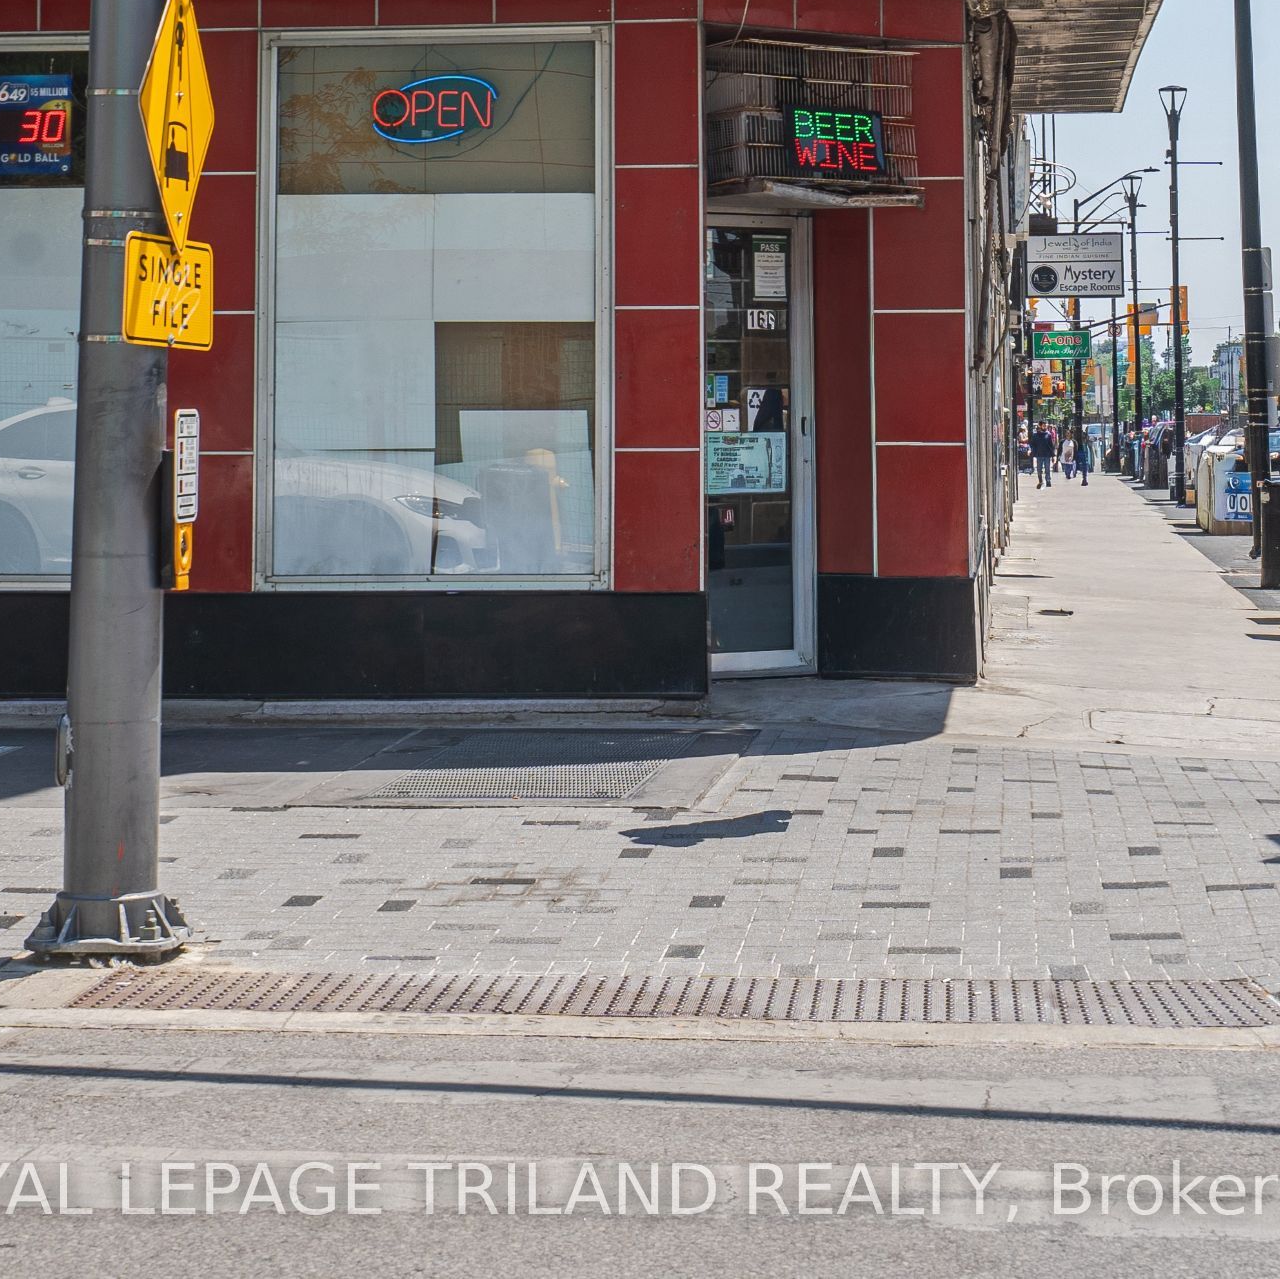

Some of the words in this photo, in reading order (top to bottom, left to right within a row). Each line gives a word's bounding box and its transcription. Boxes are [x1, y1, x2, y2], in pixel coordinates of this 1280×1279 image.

[39, 86, 69, 98] MILLION
[372, 88, 493, 129] OPEN
[19, 110, 67, 143] 30
[793, 109, 875, 143] BEER
[35, 153, 60, 163] BALL
[794, 137, 878, 172] WINE
[760, 243, 780, 252] PASS
[1091, 237, 1113, 247] India
[138, 254, 202, 289] SINGLE
[1064, 264, 1116, 283] Mystery
[1060, 283, 1089, 293] Escape
[1090, 283, 1121, 291] Rooms
[152, 299, 189, 330] FILE
[1041, 333, 1083, 345] A-one
[1036, 347, 1060, 355] Asian
